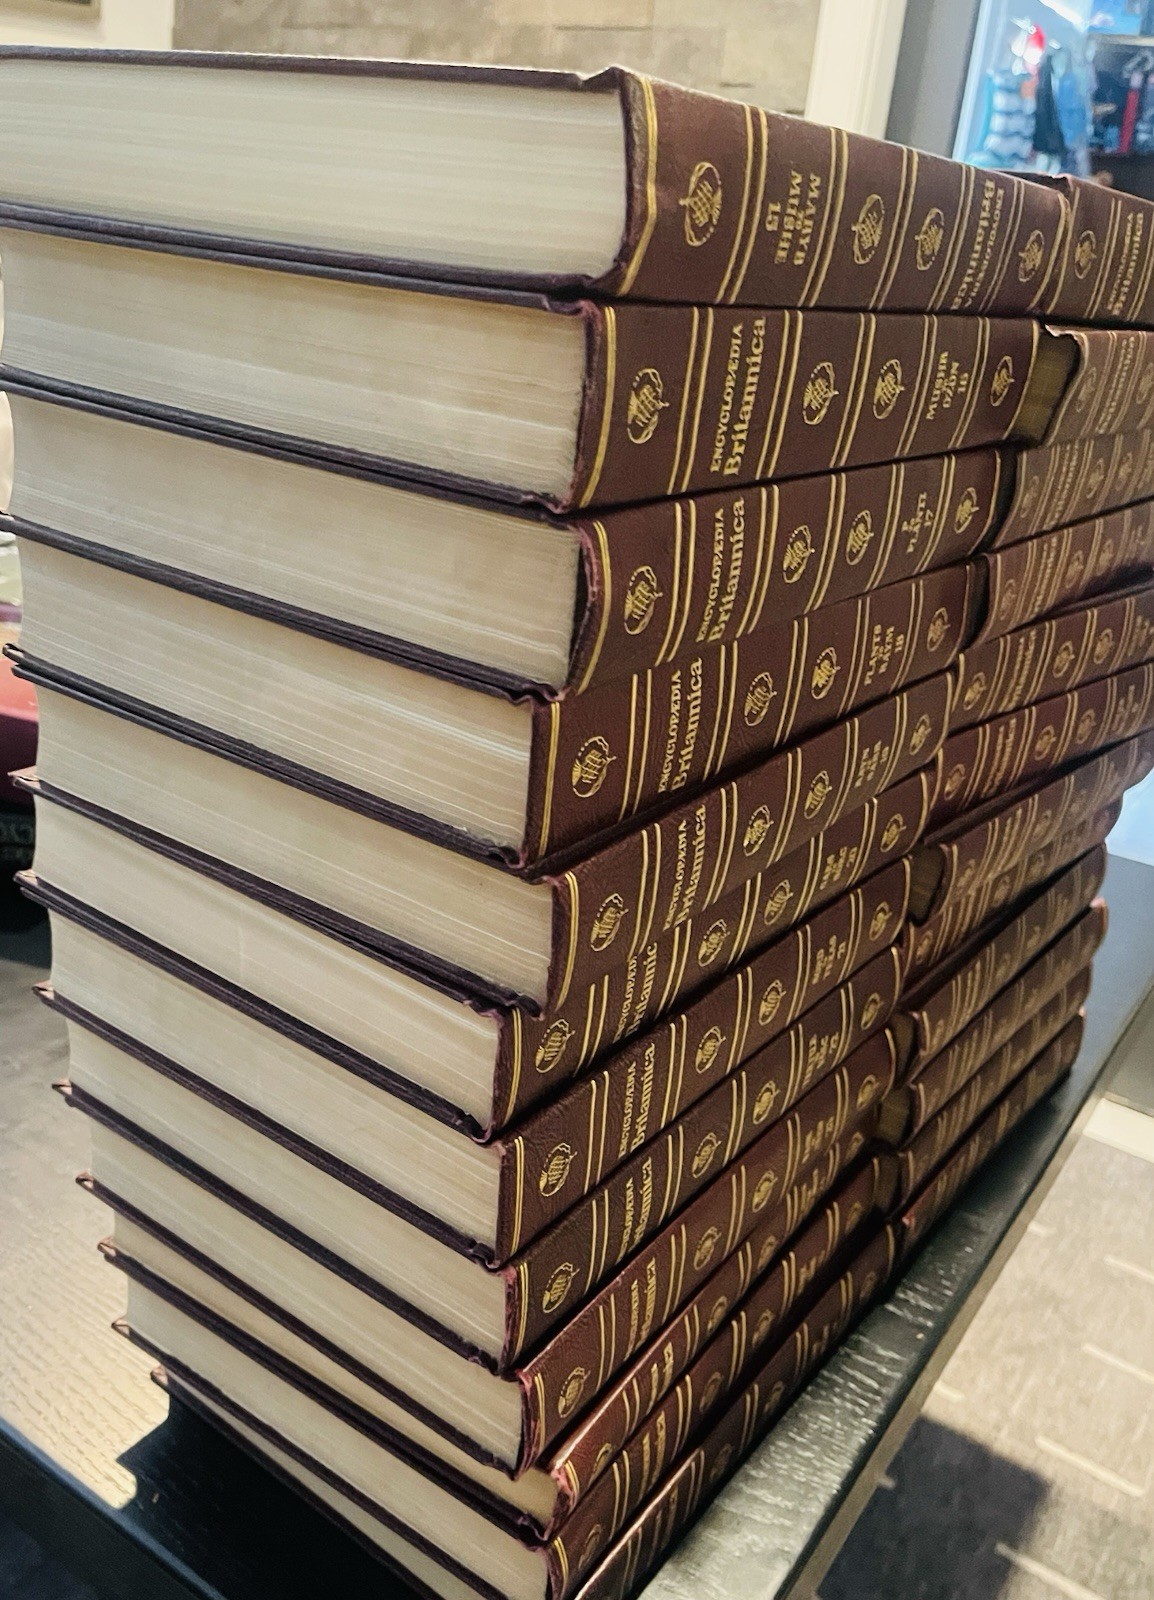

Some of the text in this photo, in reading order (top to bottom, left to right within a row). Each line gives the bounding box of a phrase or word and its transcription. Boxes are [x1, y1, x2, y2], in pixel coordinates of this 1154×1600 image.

[765, 201, 782, 231] 15
[774, 169, 803, 265] MUSHE
[722, 316, 767, 477] Britannica
[707, 496, 745, 643] Britannica
[923, 508, 934, 528] 17
[670, 657, 703, 790] Britannica
[673, 804, 706, 927] Britannica
[625, 942, 658, 1038] Britannic
[630, 1042, 656, 1152] Britannica
